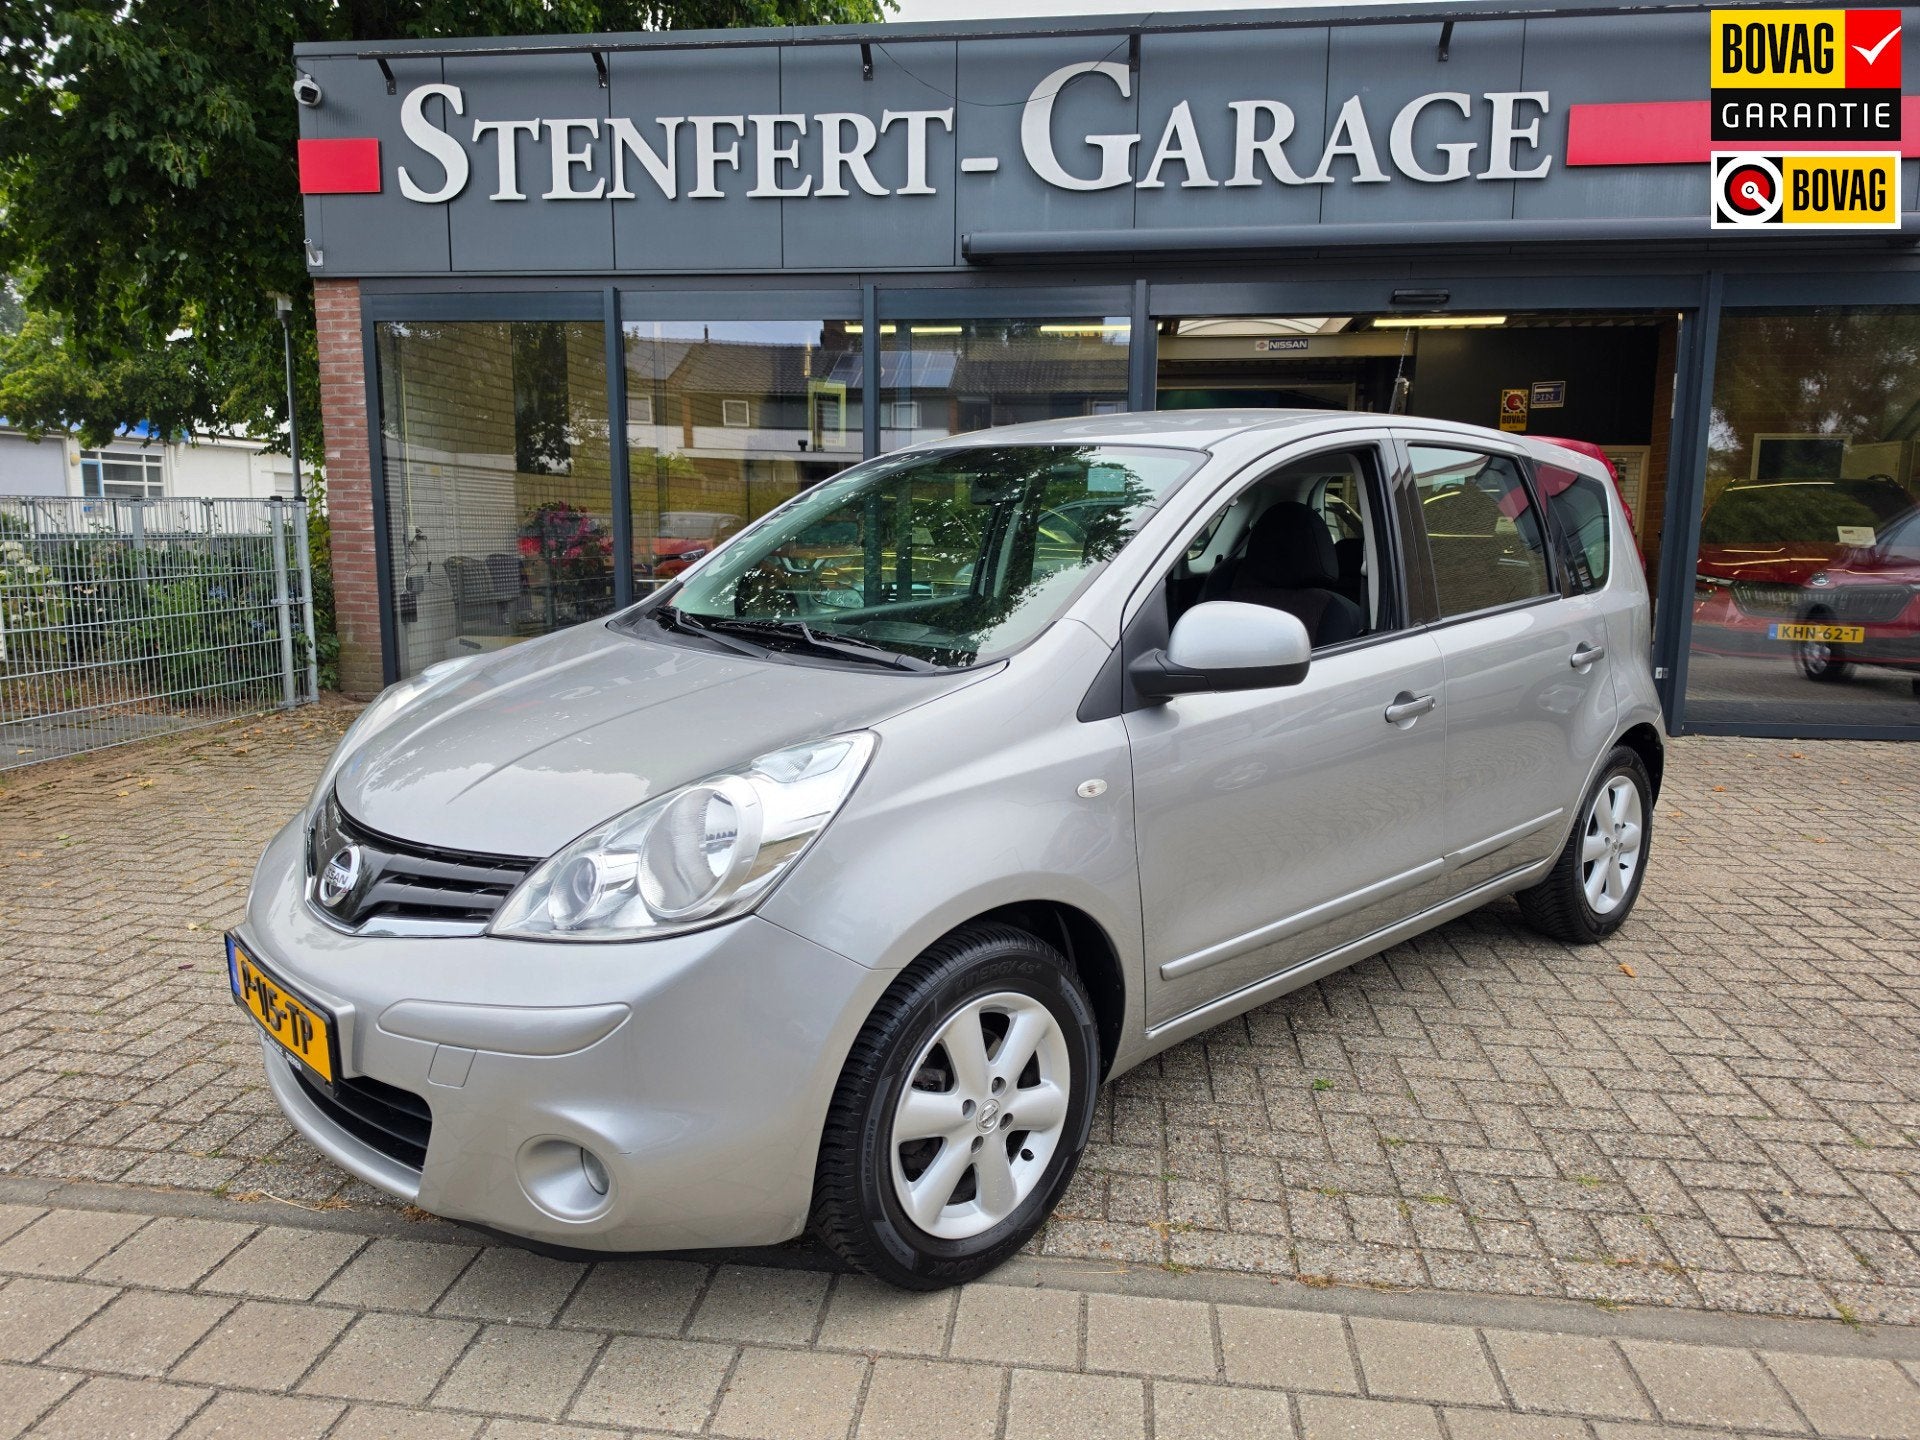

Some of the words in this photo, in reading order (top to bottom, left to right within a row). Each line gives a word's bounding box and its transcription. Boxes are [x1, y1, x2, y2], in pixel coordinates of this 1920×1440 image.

[1269, 340, 1308, 350] NISSAN
[1501, 414, 1527, 425] BOVAG
[1782, 626, 1860, 641] KHN-62-T
